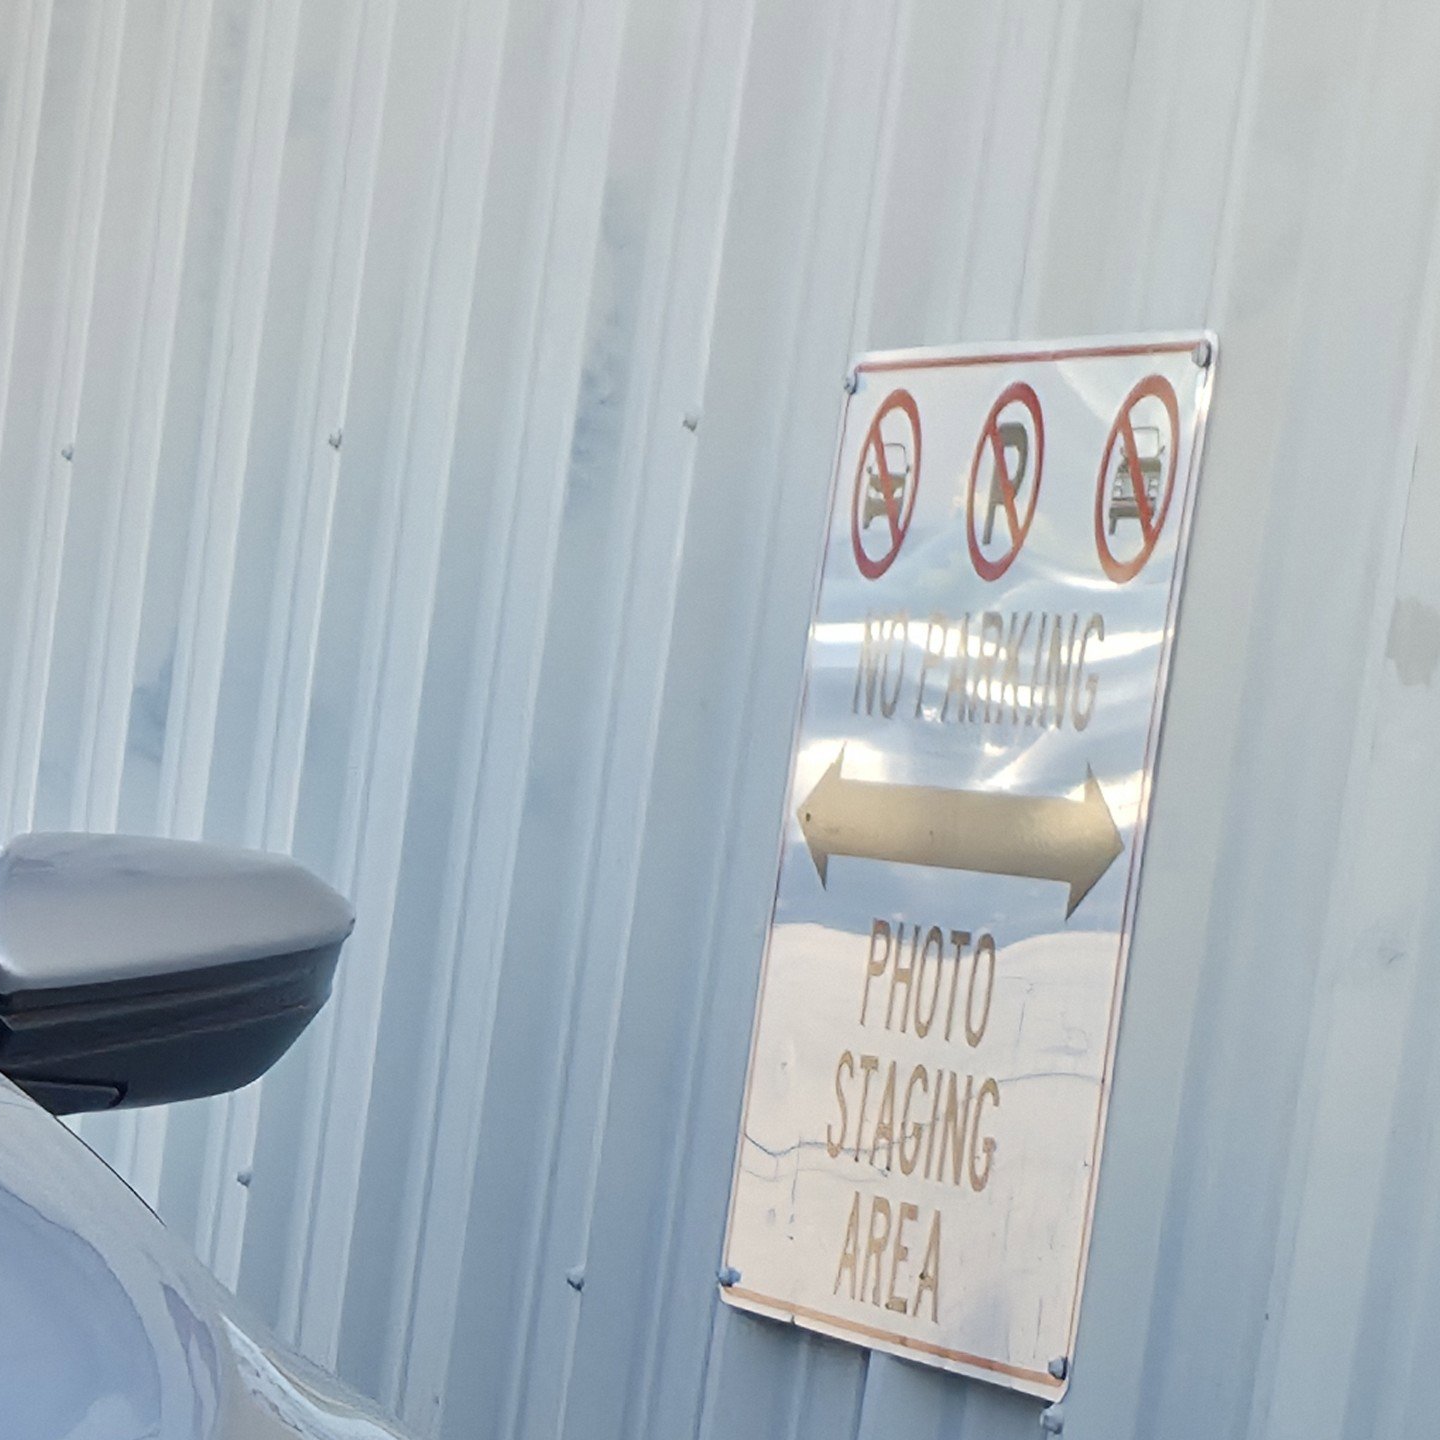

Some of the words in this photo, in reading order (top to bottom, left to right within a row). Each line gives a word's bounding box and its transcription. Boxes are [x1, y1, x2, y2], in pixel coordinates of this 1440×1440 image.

[853, 607, 909, 720] NO
[915, 610, 1105, 733] PARKING
[860, 917, 996, 1048] PHOTO
[827, 1049, 1000, 1192] STAGING
[833, 1190, 941, 1324] AREA
